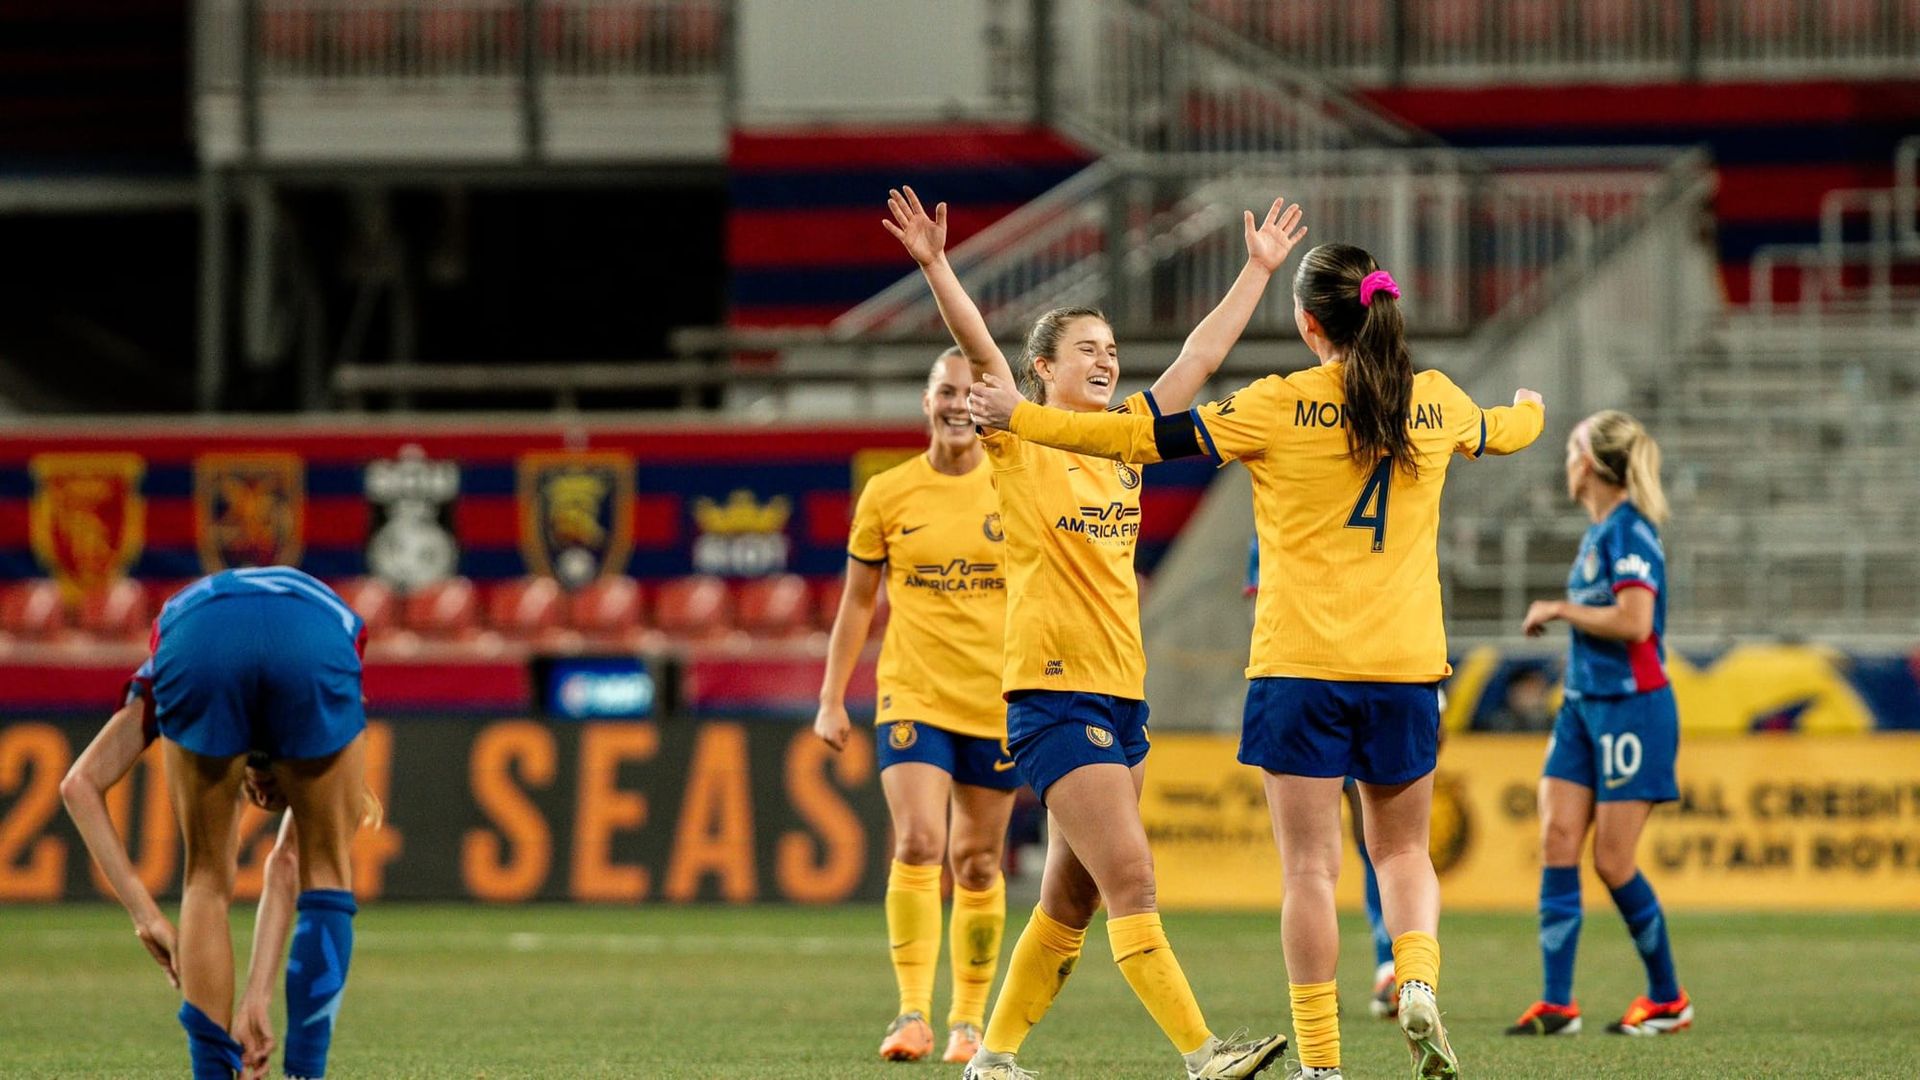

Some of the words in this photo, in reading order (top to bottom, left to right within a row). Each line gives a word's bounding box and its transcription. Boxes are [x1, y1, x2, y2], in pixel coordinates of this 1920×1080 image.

[1343, 453, 1394, 553] 4
[1055, 515, 1119, 538] AMRICA
[1044, 667, 1063, 676] UTAH
[1047, 659, 1063, 667] ONE
[1600, 732, 1642, 776] 10
[1807, 835, 1920, 873] ROY
